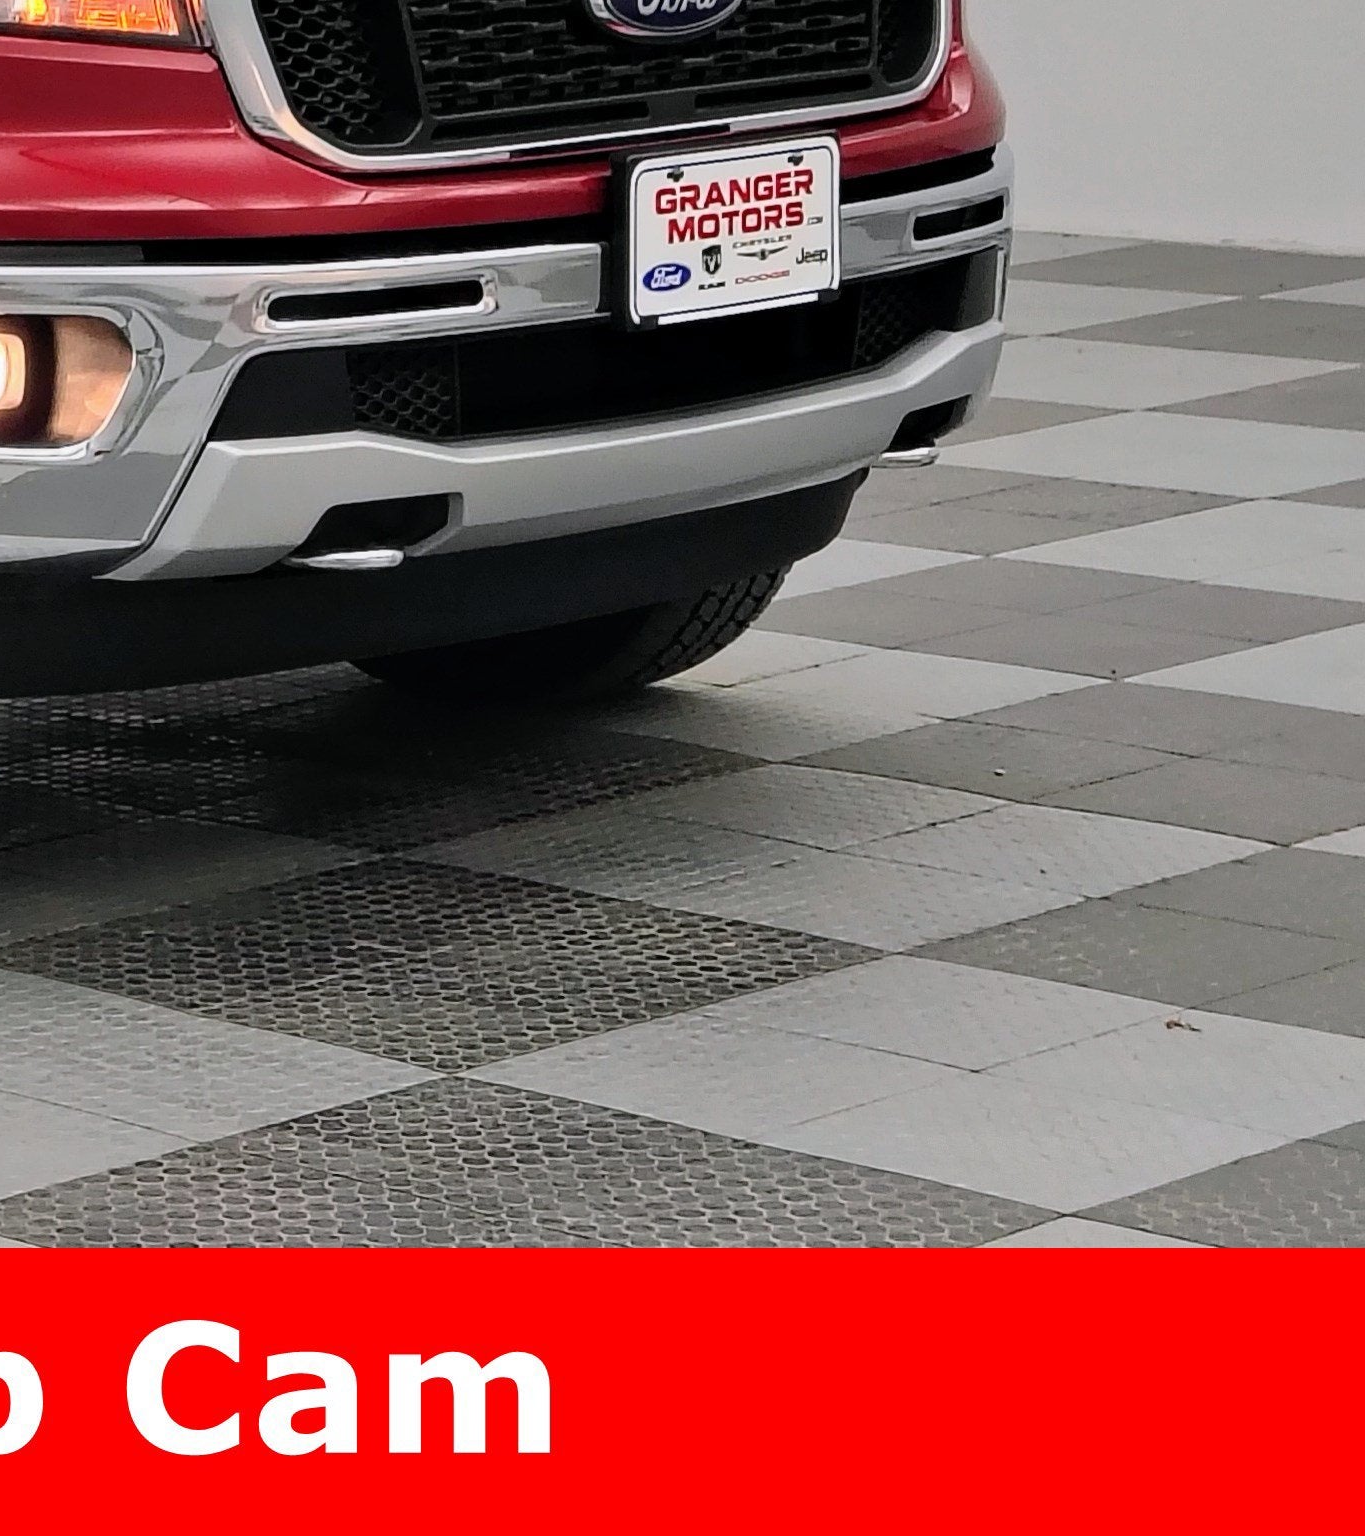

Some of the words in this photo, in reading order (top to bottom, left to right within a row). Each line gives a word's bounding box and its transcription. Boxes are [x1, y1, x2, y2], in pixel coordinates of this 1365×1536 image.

[655, 168, 813, 215] GRANGER
[667, 201, 805, 244] MOTORS
[650, 266, 683, 289] Ford
